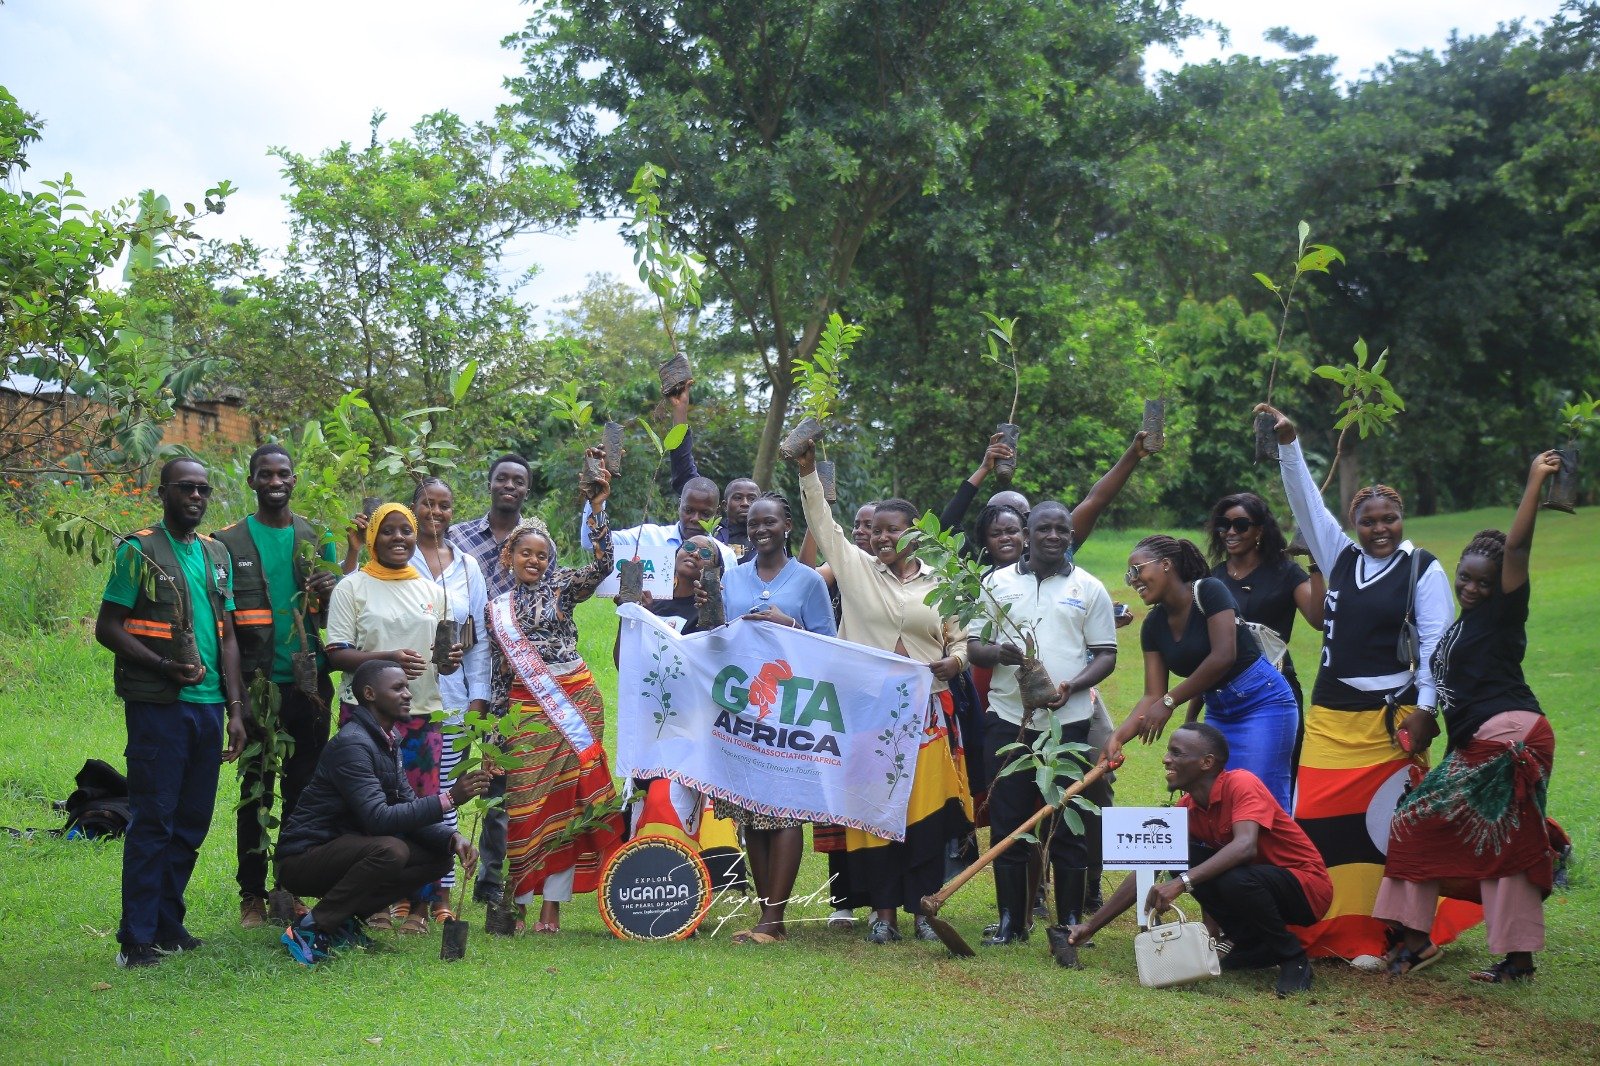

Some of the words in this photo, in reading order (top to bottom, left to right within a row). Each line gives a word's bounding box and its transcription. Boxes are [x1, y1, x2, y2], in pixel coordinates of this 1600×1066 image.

[497, 621, 517, 652] TOURISM
[513, 652, 531, 675] SOUTH
[528, 672, 547, 694] WEST
[713, 709, 842, 757] AFRICA
[711, 729, 726, 741] GIRLS
[734, 739, 761, 753] TOURISM
[760, 748, 813, 761] ASSOCIATION
[813, 756, 842, 767] AFRICA
[766, 762, 794, 774] Through
[796, 766, 823, 776] Tourism
[619, 884, 689, 901] UGANDA
[635, 876, 673, 884] EXPLORE
